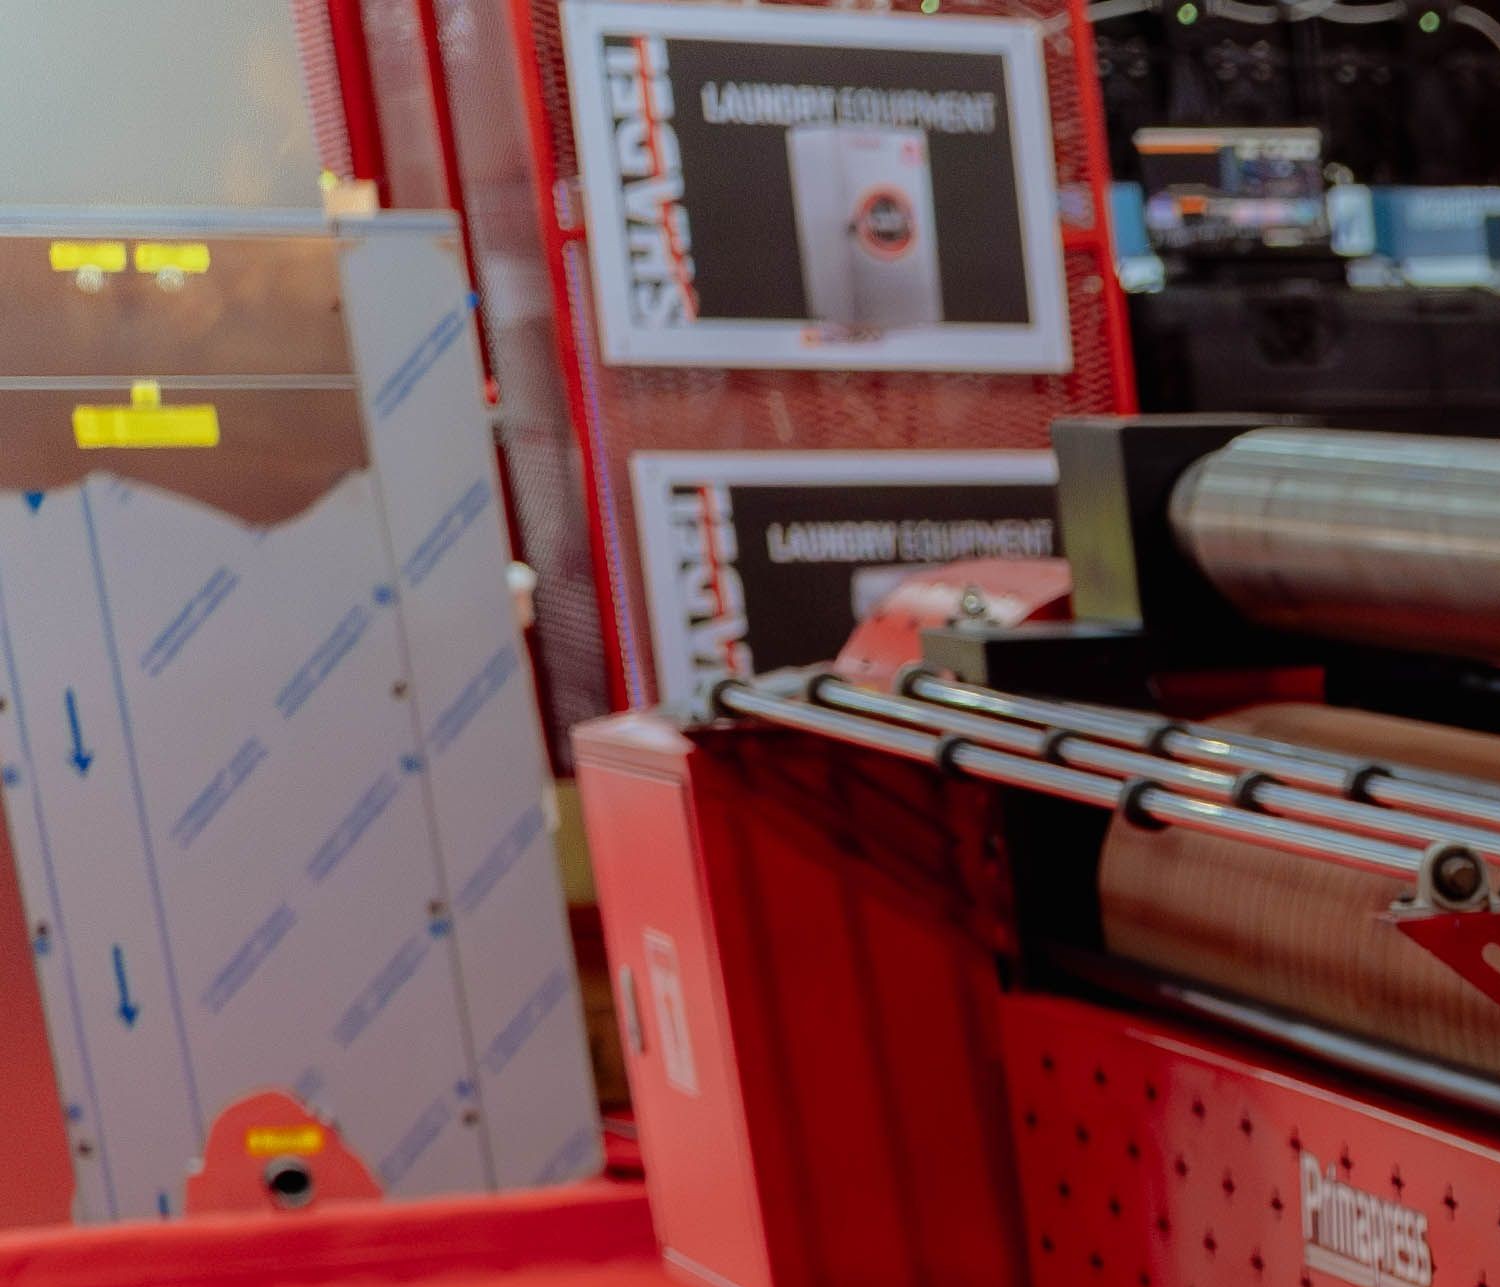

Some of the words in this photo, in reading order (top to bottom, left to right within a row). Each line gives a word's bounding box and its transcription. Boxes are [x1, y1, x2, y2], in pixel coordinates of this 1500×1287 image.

[701, 81, 836, 126] LAUNDRY
[841, 86, 996, 133] EQUIPMENT
[766, 520, 896, 563] LAUNDRY
[899, 517, 1054, 562] EQUIPMENT
